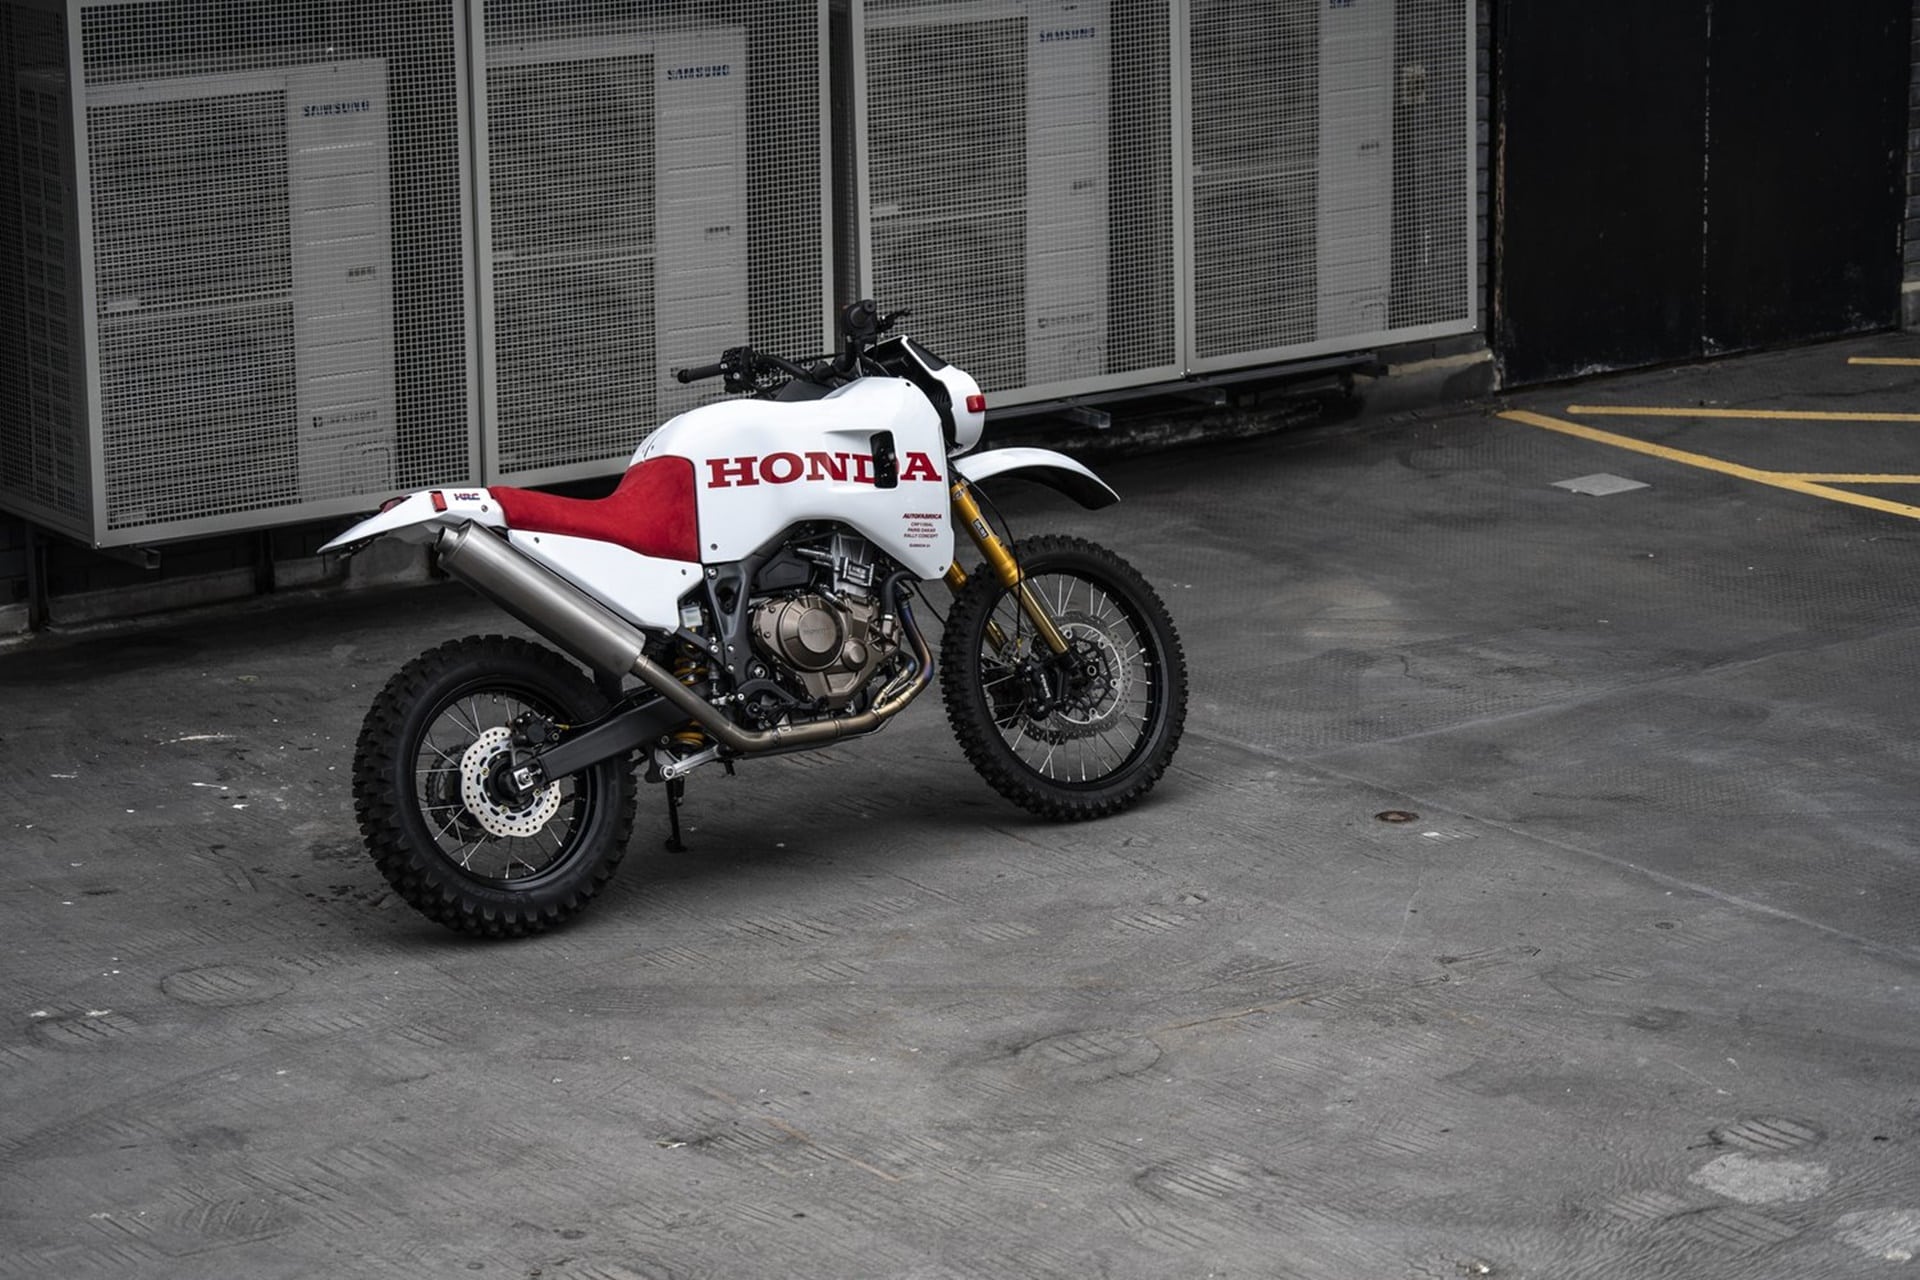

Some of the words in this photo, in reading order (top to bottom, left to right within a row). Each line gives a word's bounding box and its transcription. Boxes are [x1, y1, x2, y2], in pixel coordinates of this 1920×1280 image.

[667, 64, 730, 80] SAMSUNG
[303, 101, 369, 117] SAMSUNG
[453, 493, 480, 501] HRC
